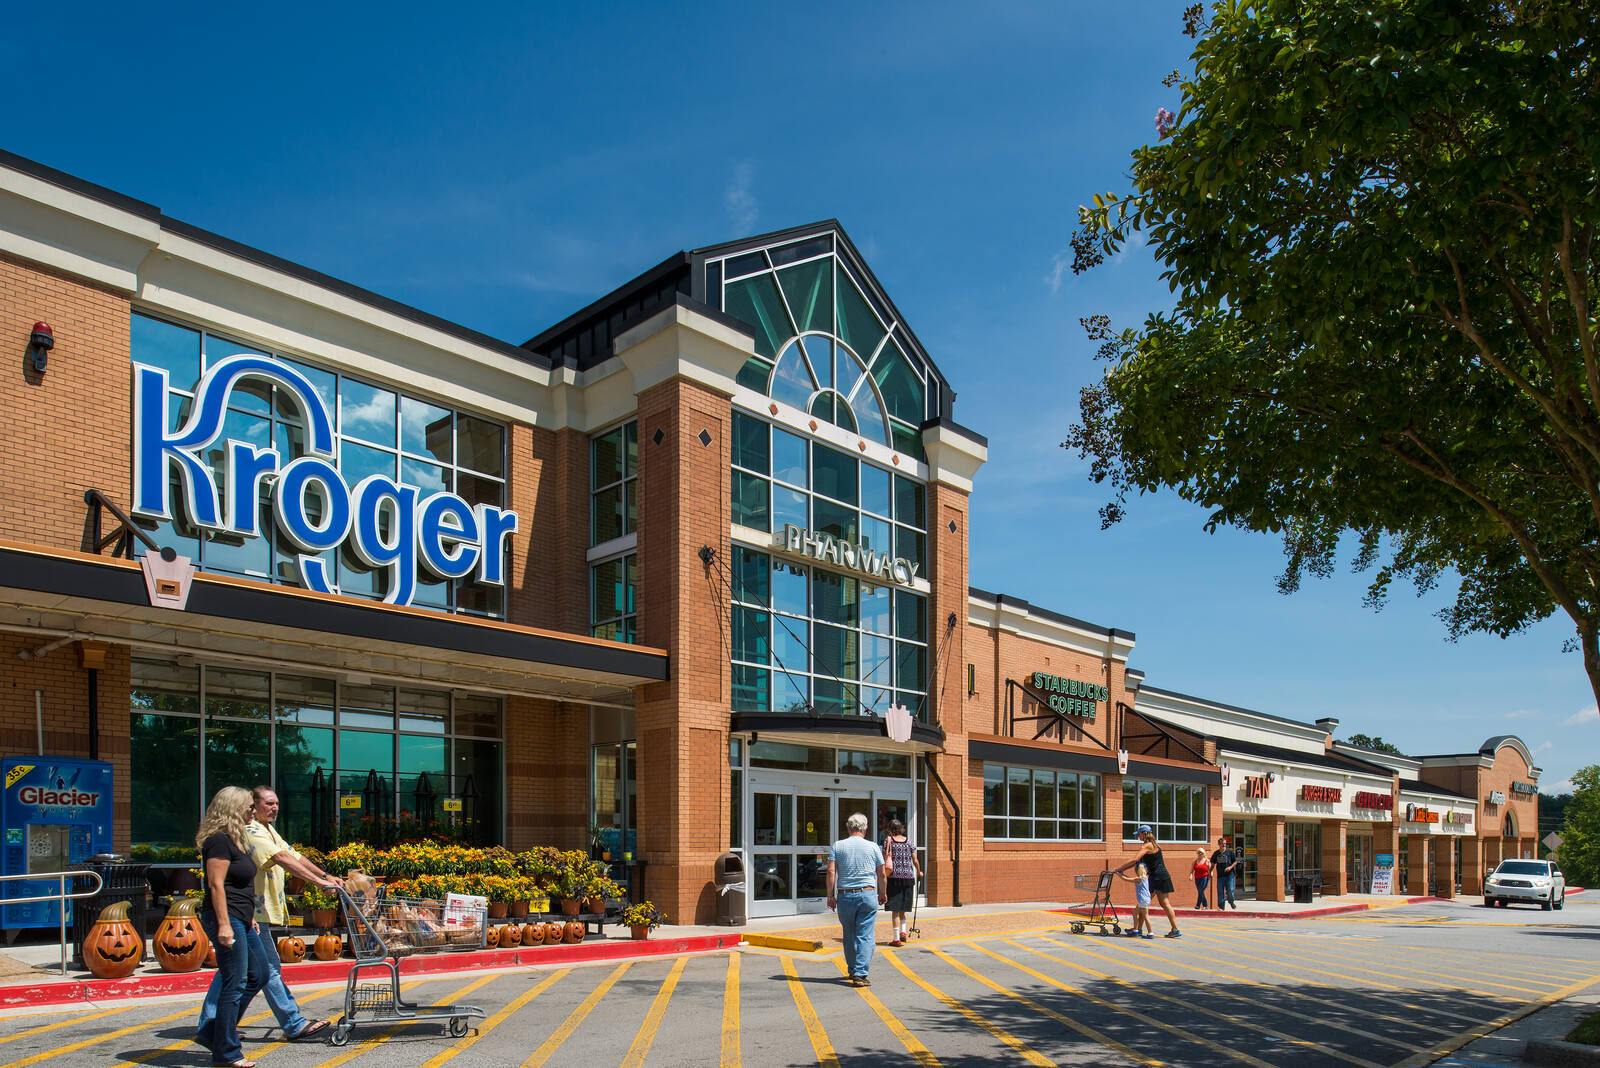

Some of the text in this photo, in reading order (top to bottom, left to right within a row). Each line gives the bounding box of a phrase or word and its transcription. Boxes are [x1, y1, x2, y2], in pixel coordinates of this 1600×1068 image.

[132, 354, 519, 606] Kroger
[784, 523, 919, 586] PHARMACY
[1034, 671, 1109, 702] STARBUCKS
[1049, 694, 1096, 718] COFFEE
[19, 787, 99, 806] Glacier
[1248, 776, 1270, 798] TAN
